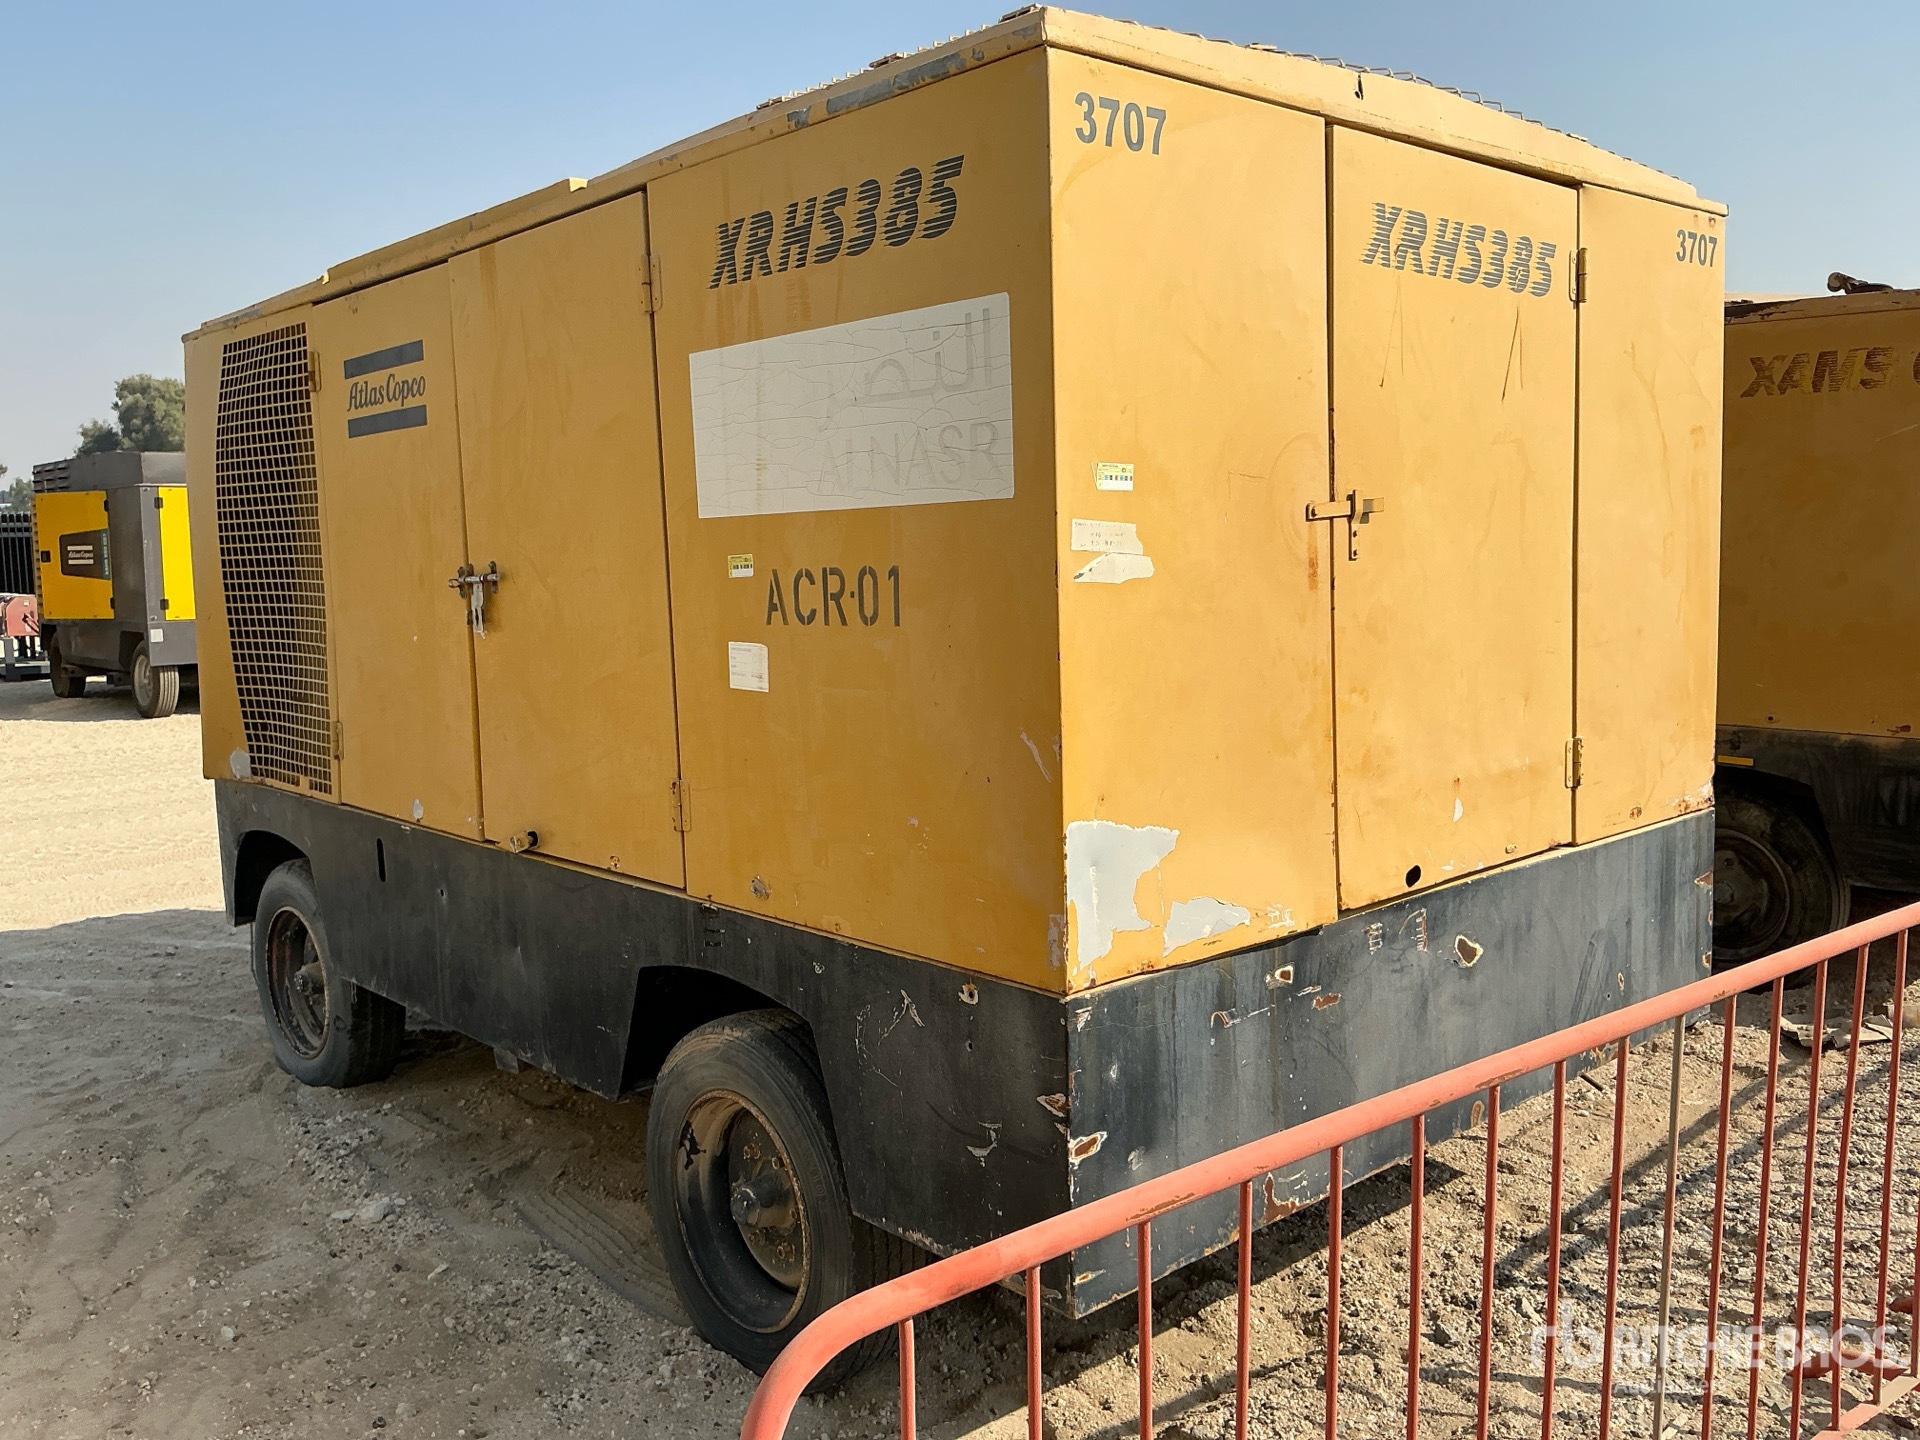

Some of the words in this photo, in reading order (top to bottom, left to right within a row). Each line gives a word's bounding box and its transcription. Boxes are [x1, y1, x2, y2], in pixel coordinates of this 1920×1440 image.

[1074, 91, 1167, 155] 3707
[706, 155, 965, 289] XRHS385
[1359, 202, 1557, 298] XRHS385
[1676, 229, 1718, 268] 3707
[347, 381, 385, 412] Atlas
[386, 373, 426, 407] Copco
[1739, 346, 1898, 398] XAMS
